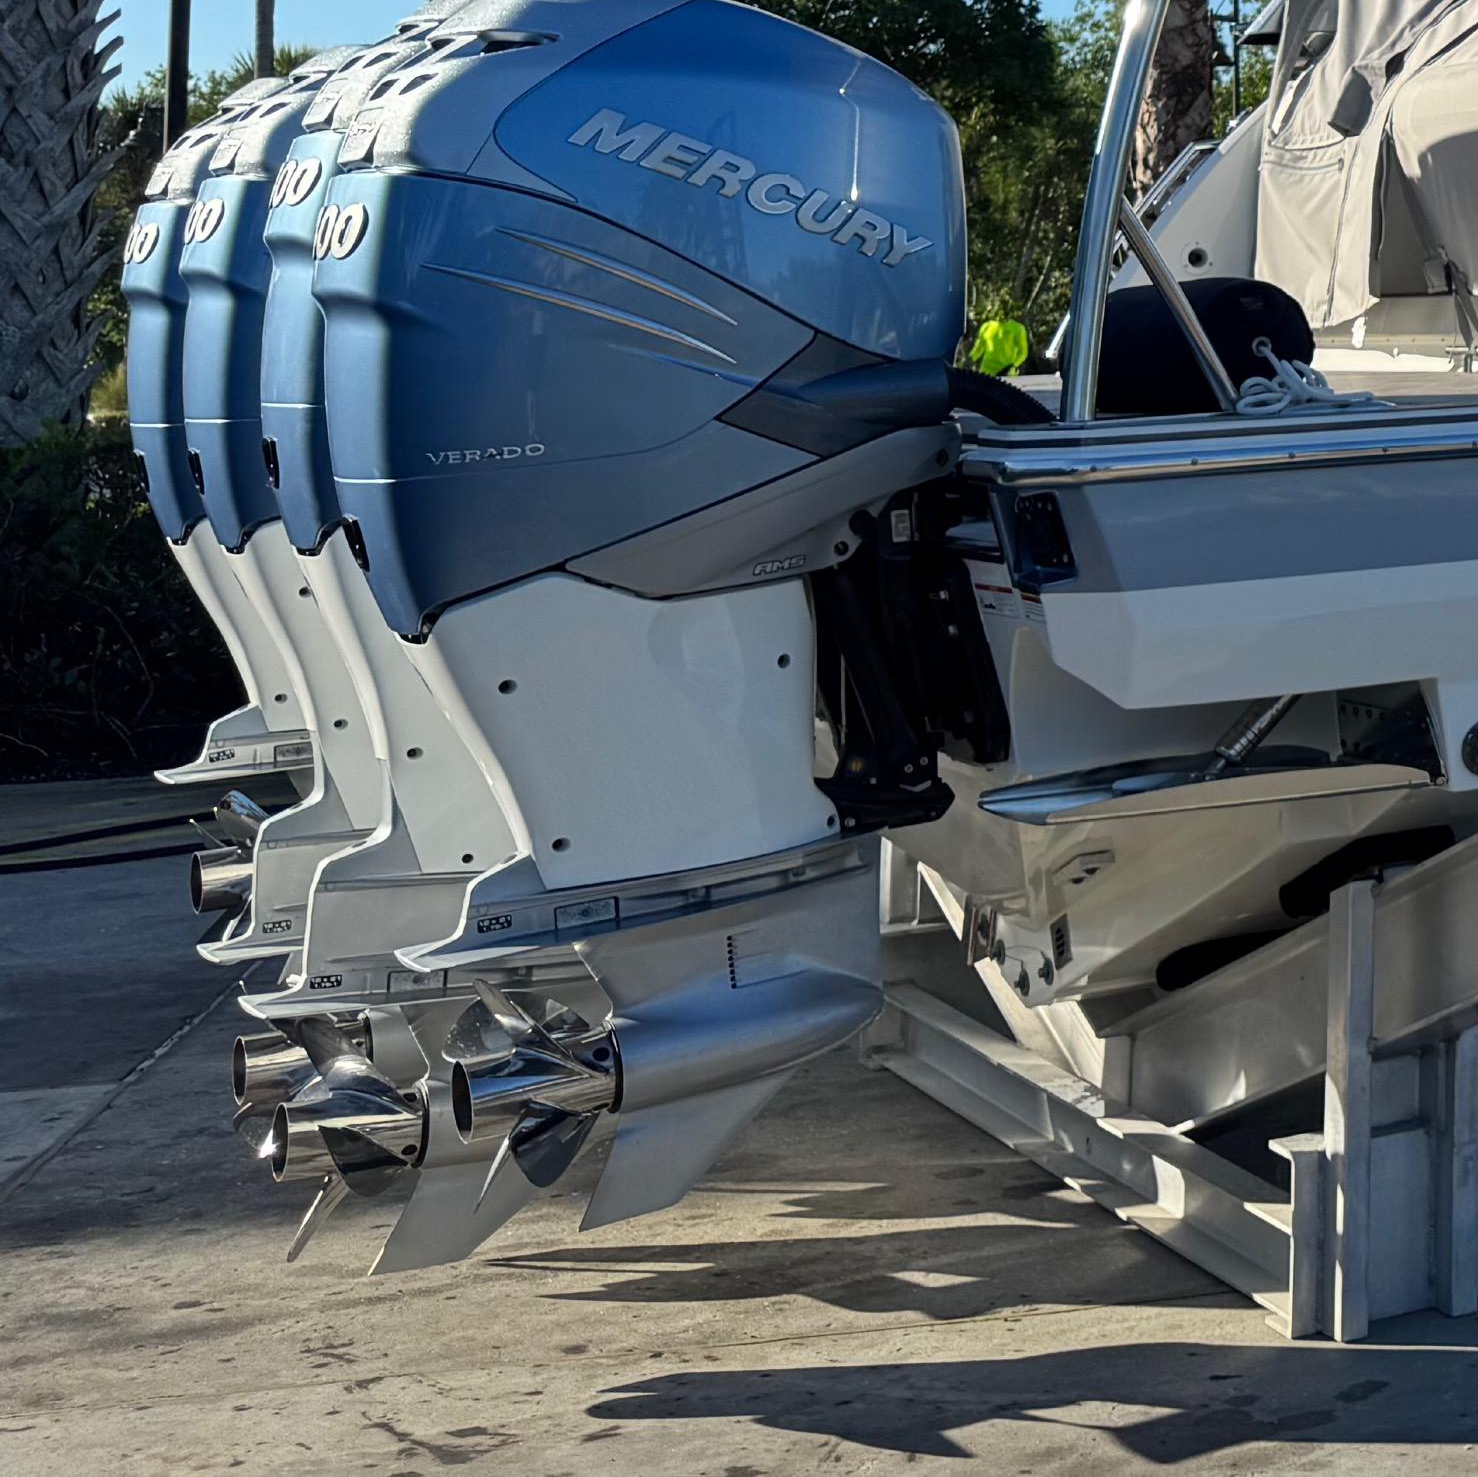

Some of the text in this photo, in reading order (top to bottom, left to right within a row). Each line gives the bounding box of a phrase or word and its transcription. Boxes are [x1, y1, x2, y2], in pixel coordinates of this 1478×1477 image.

[269, 156, 322, 209] 00
[567, 107, 935, 268] MERCURY
[123, 223, 160, 264] 00
[184, 198, 225, 245] 00
[312, 202, 369, 260] 00
[425, 443, 545, 465] VERADO
